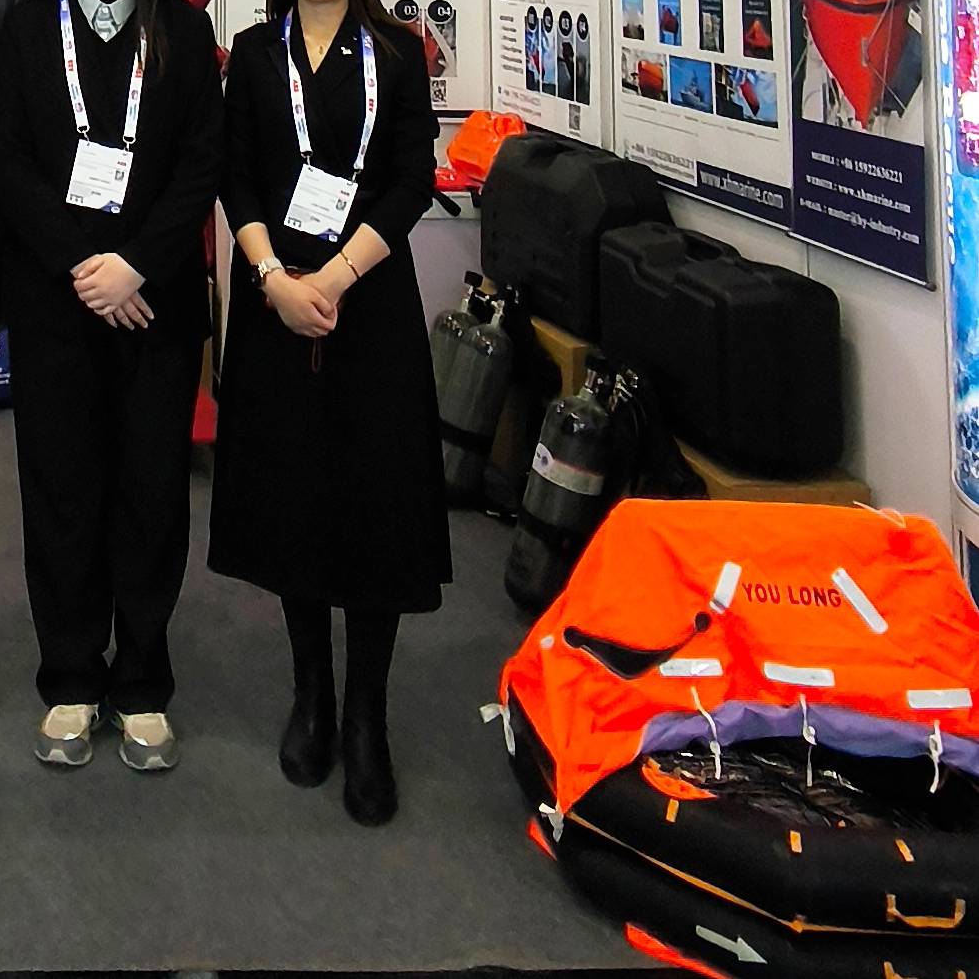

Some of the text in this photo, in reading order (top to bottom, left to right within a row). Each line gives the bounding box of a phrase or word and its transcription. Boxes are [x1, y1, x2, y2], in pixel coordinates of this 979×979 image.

[404, 5, 417, 16] 03
[437, 6, 451, 17] 04
[741, 582, 841, 608] YOU LONG
